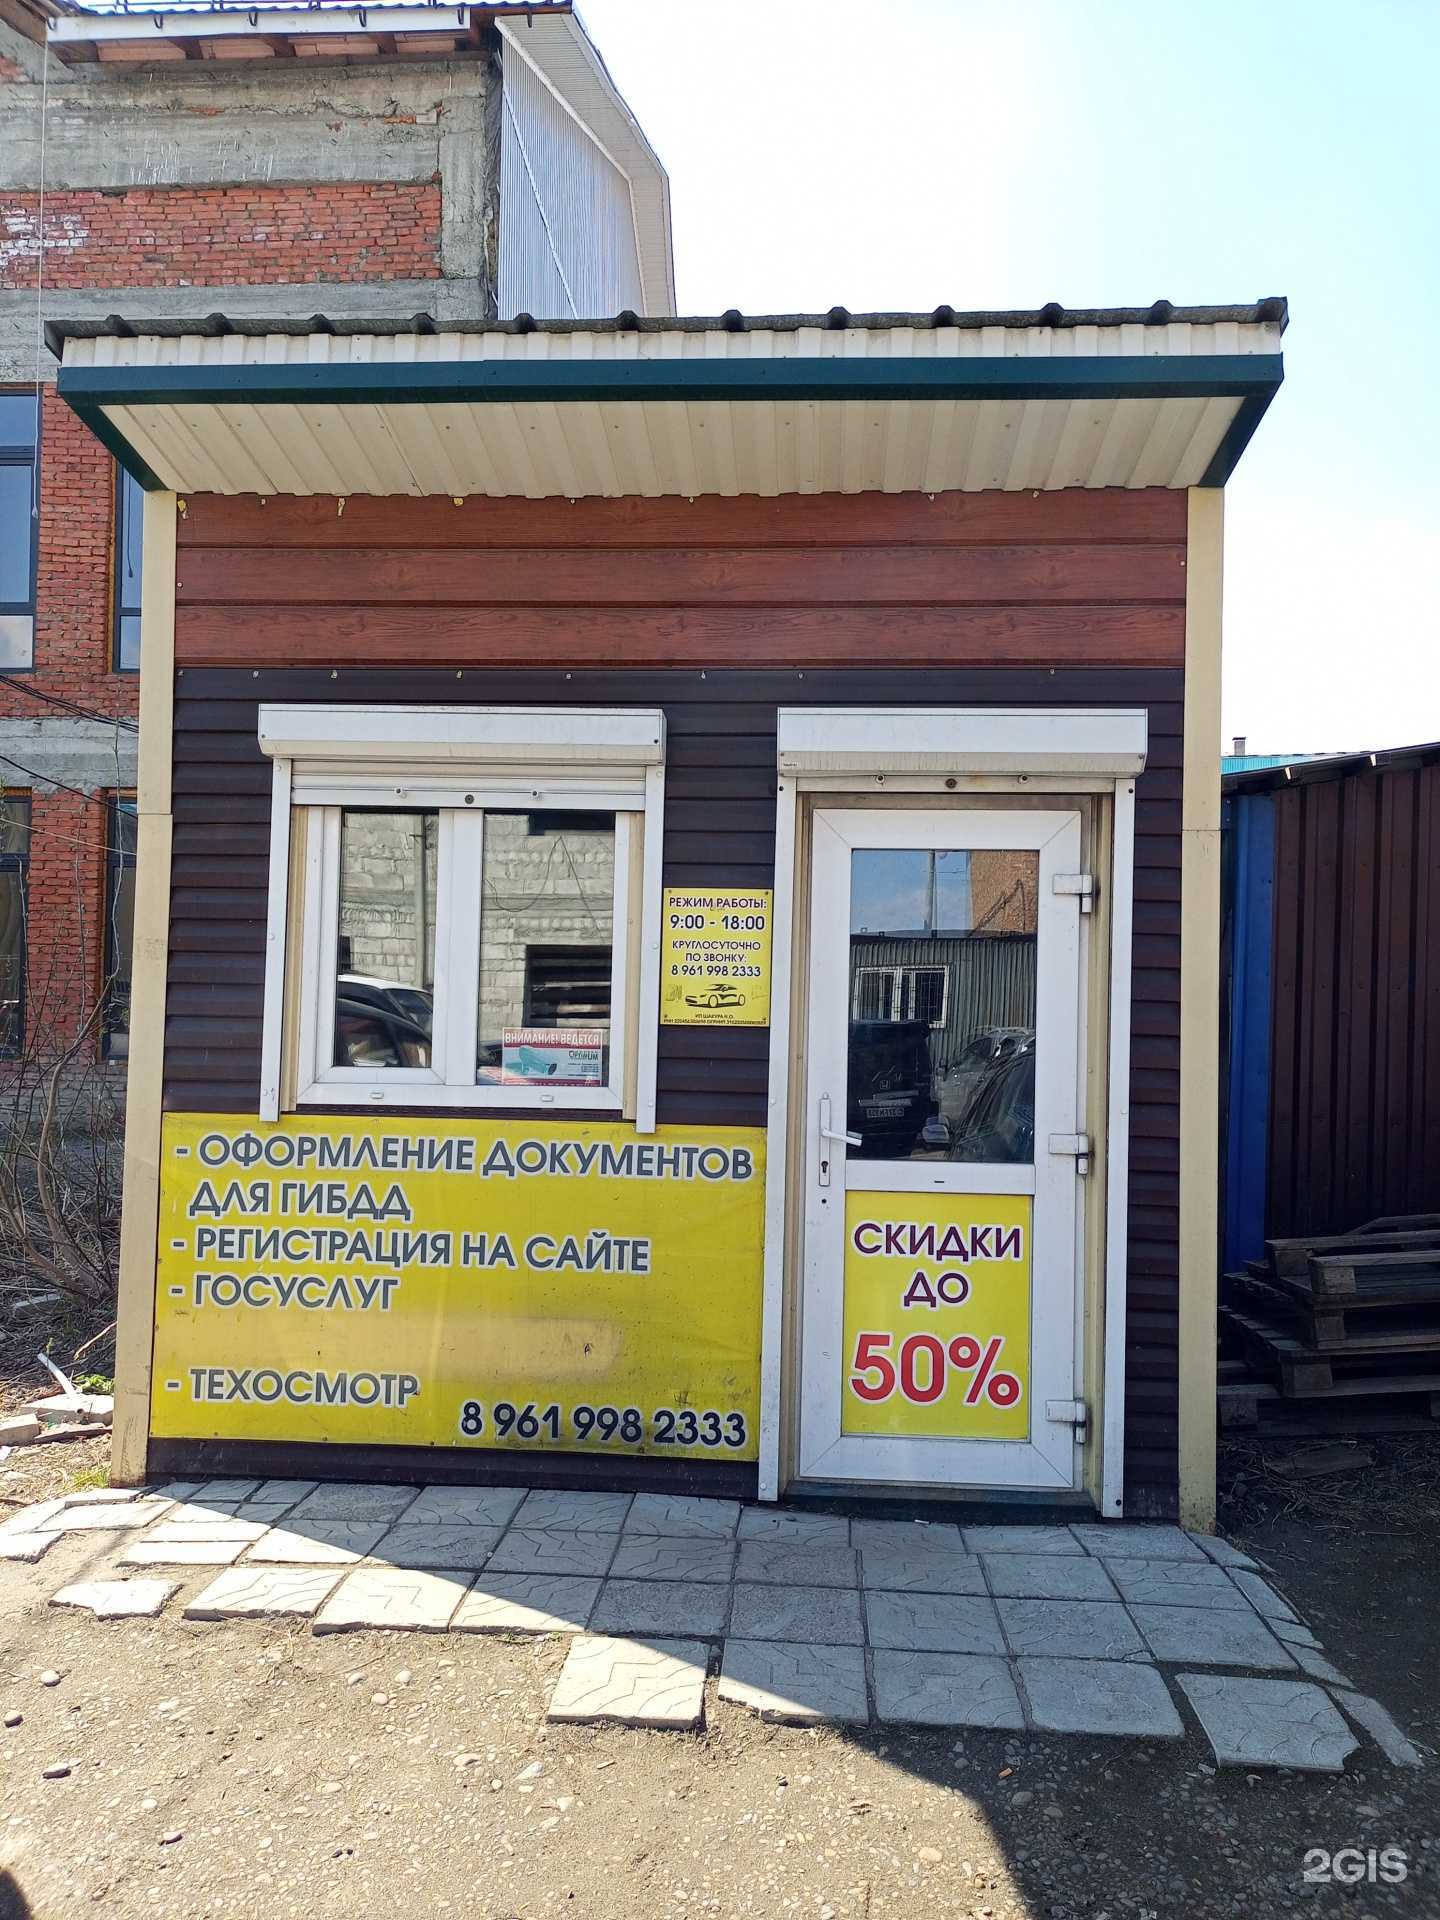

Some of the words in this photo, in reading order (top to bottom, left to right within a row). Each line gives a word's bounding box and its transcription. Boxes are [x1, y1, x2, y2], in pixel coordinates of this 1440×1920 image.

[669, 897, 713, 908] РЕЖИМ
[716, 898, 767, 909] РАБОТЫ:
[670, 914, 705, 929] 9:00
[721, 915, 765, 930] 18:00
[672, 940, 761, 951] КРУГЛОСУТОЧНО
[685, 952, 701, 962] ПО
[703, 953, 747, 963] ЗВОНКУ:
[671, 964, 679, 976] 8
[681, 964, 703, 976] 961
[706, 965, 729, 977] 998
[731, 965, 761, 977] 2333
[505, 1031, 560, 1045] ВНИМАНИЕ!
[199, 1133, 474, 1171] ОФОРМЛЕНИЕ
[482, 1140, 752, 1179] ДОКУМЕНТОВ
[189, 1181, 269, 1217] ДЛЯ
[281, 1183, 411, 1221] ГИБДД
[197, 1228, 451, 1268] РЕГИСТРАЦИЯ
[463, 1234, 516, 1267] НА
[525, 1231, 649, 1272] САЙТЕ
[853, 1222, 1021, 1262] СКИДКИ
[195, 1274, 398, 1309] ГОСУСЛУГ
[903, 1271, 969, 1308] ДО
[190, 1368, 418, 1405] ТЕХОСМОТР
[851, 1333, 1020, 1406] 50%
[461, 1401, 483, 1436] 8
[493, 1403, 560, 1440] 961
[573, 1406, 643, 1444] 998
[653, 1408, 747, 1448] 2333
